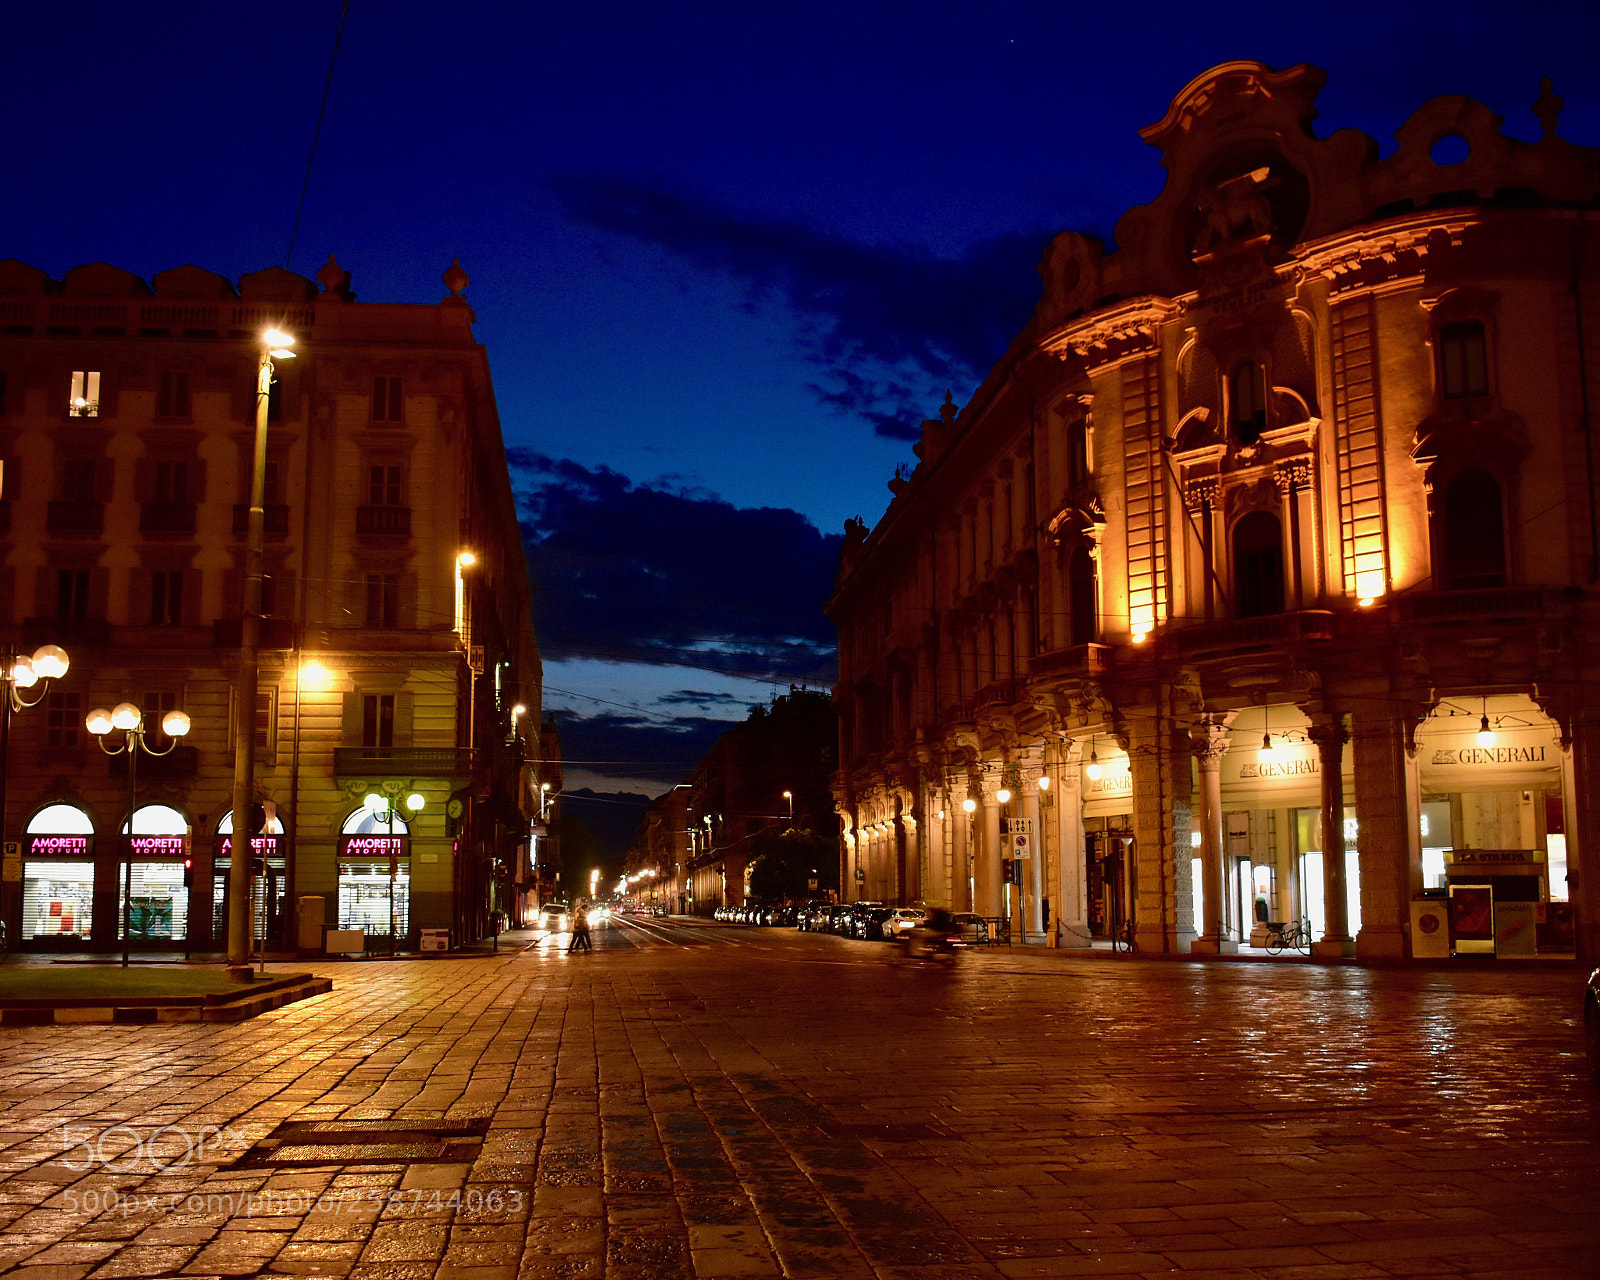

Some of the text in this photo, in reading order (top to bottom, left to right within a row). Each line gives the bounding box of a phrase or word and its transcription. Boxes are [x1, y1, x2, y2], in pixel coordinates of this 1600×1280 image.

[1459, 746, 1546, 764] GENERALI
[1103, 775, 1133, 791] GENER
[31, 838, 87, 848] AMORETTI
[131, 838, 182, 848] AMORETTI
[222, 838, 277, 848] ARETTI
[347, 838, 402, 848] AMORETTI
[1479, 853, 1525, 862] STAMPA
